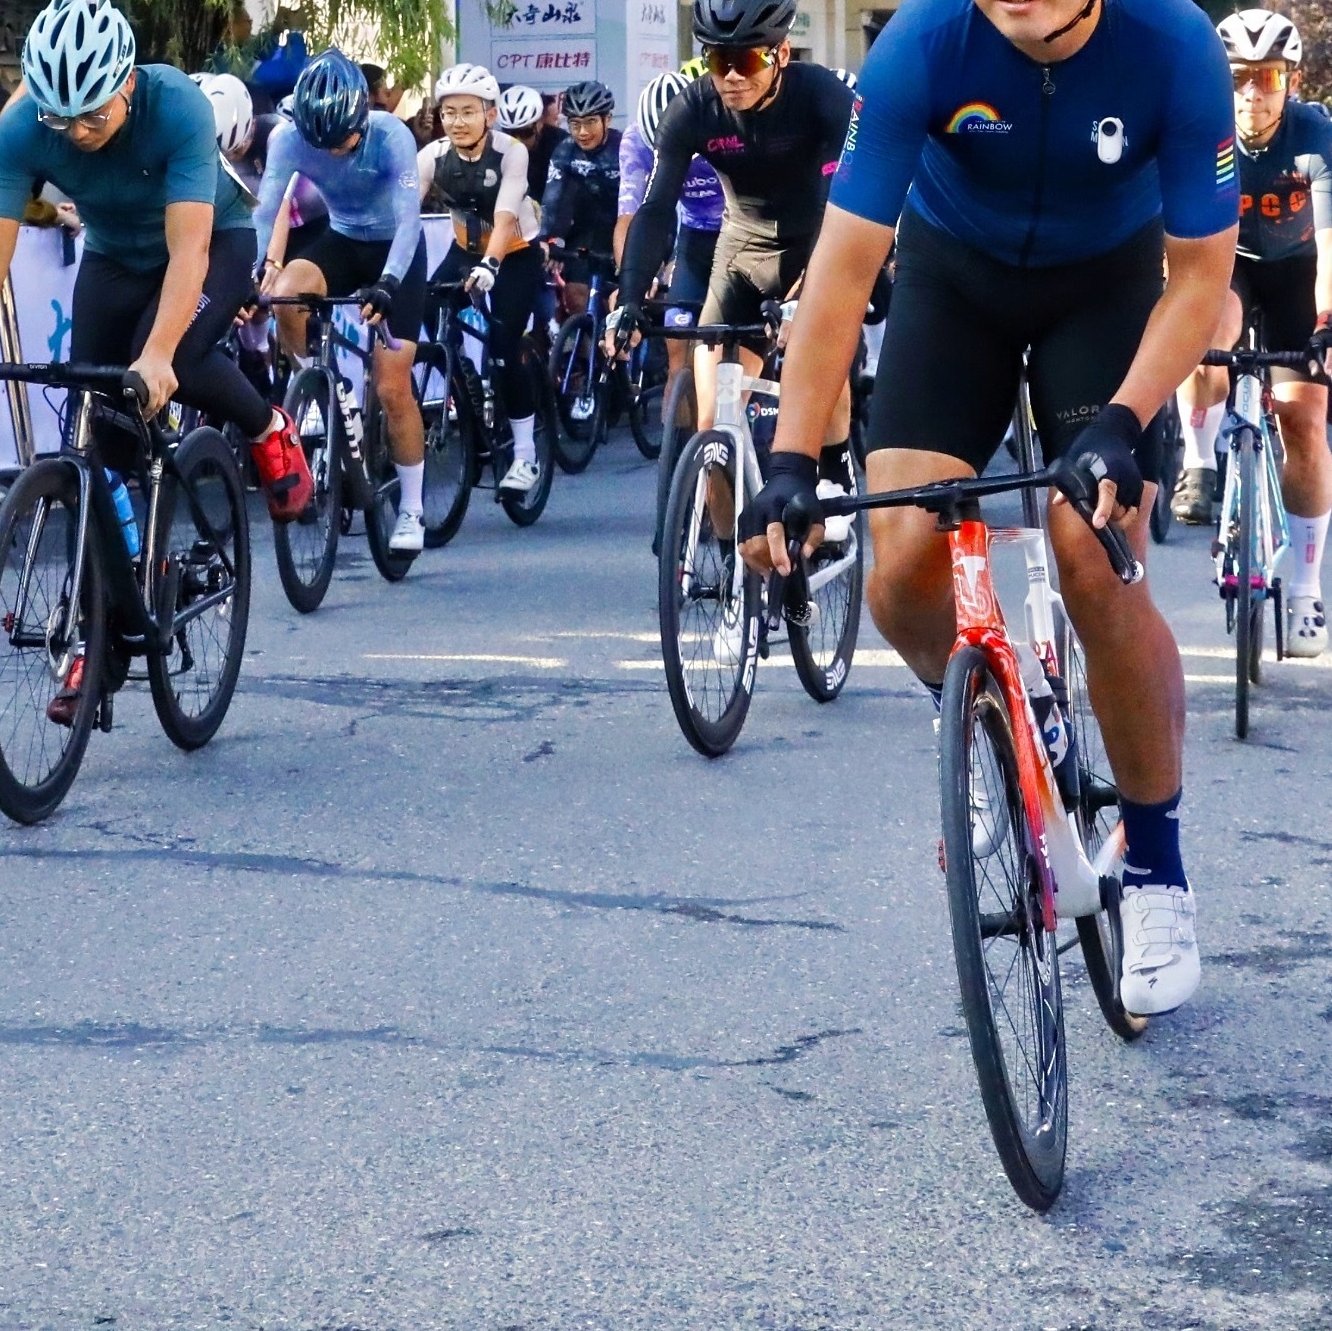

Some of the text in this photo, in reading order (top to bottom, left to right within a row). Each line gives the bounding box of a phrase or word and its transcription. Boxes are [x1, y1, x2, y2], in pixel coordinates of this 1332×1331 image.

[497, 52, 591, 69] CPT 康比特
[967, 123, 1013, 131] RAINBOW
